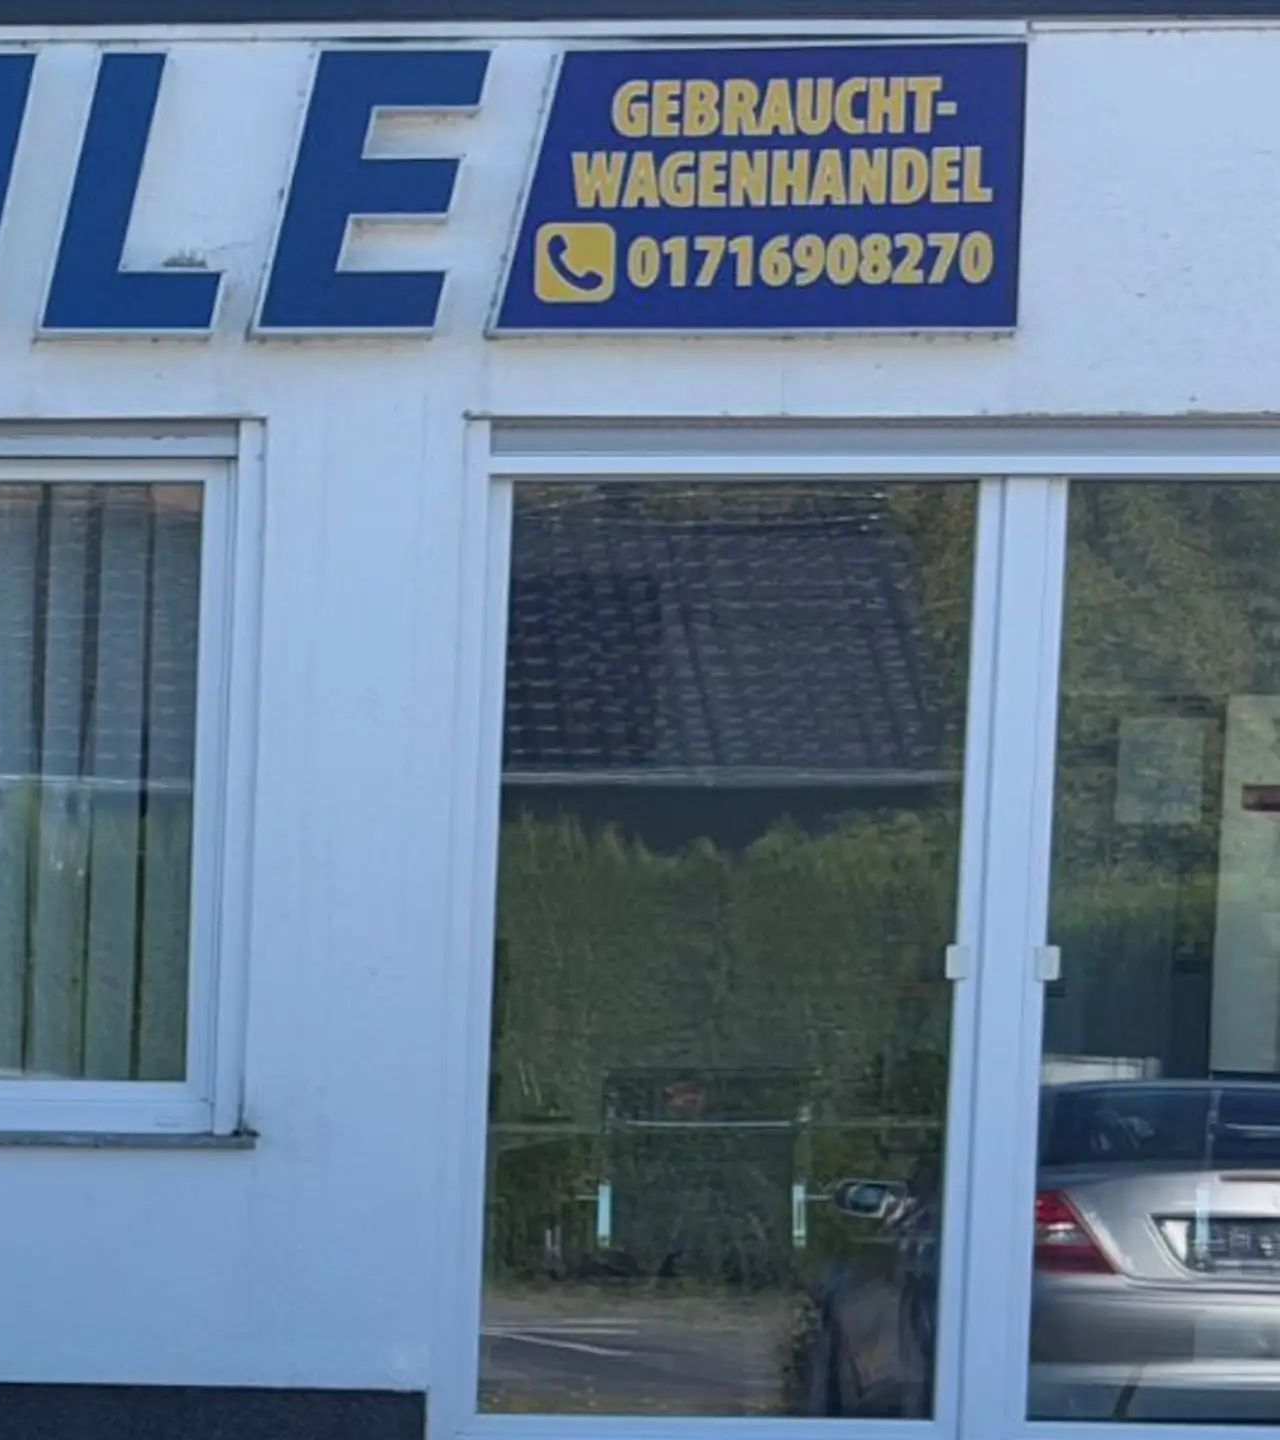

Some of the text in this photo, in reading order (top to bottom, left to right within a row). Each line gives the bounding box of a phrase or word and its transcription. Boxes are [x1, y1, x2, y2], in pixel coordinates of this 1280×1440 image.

[611, 76, 957, 138] GEBRAUCHT-
[571, 146, 993, 208] WAGENHANDEL
[626, 231, 994, 287] 01716908270
